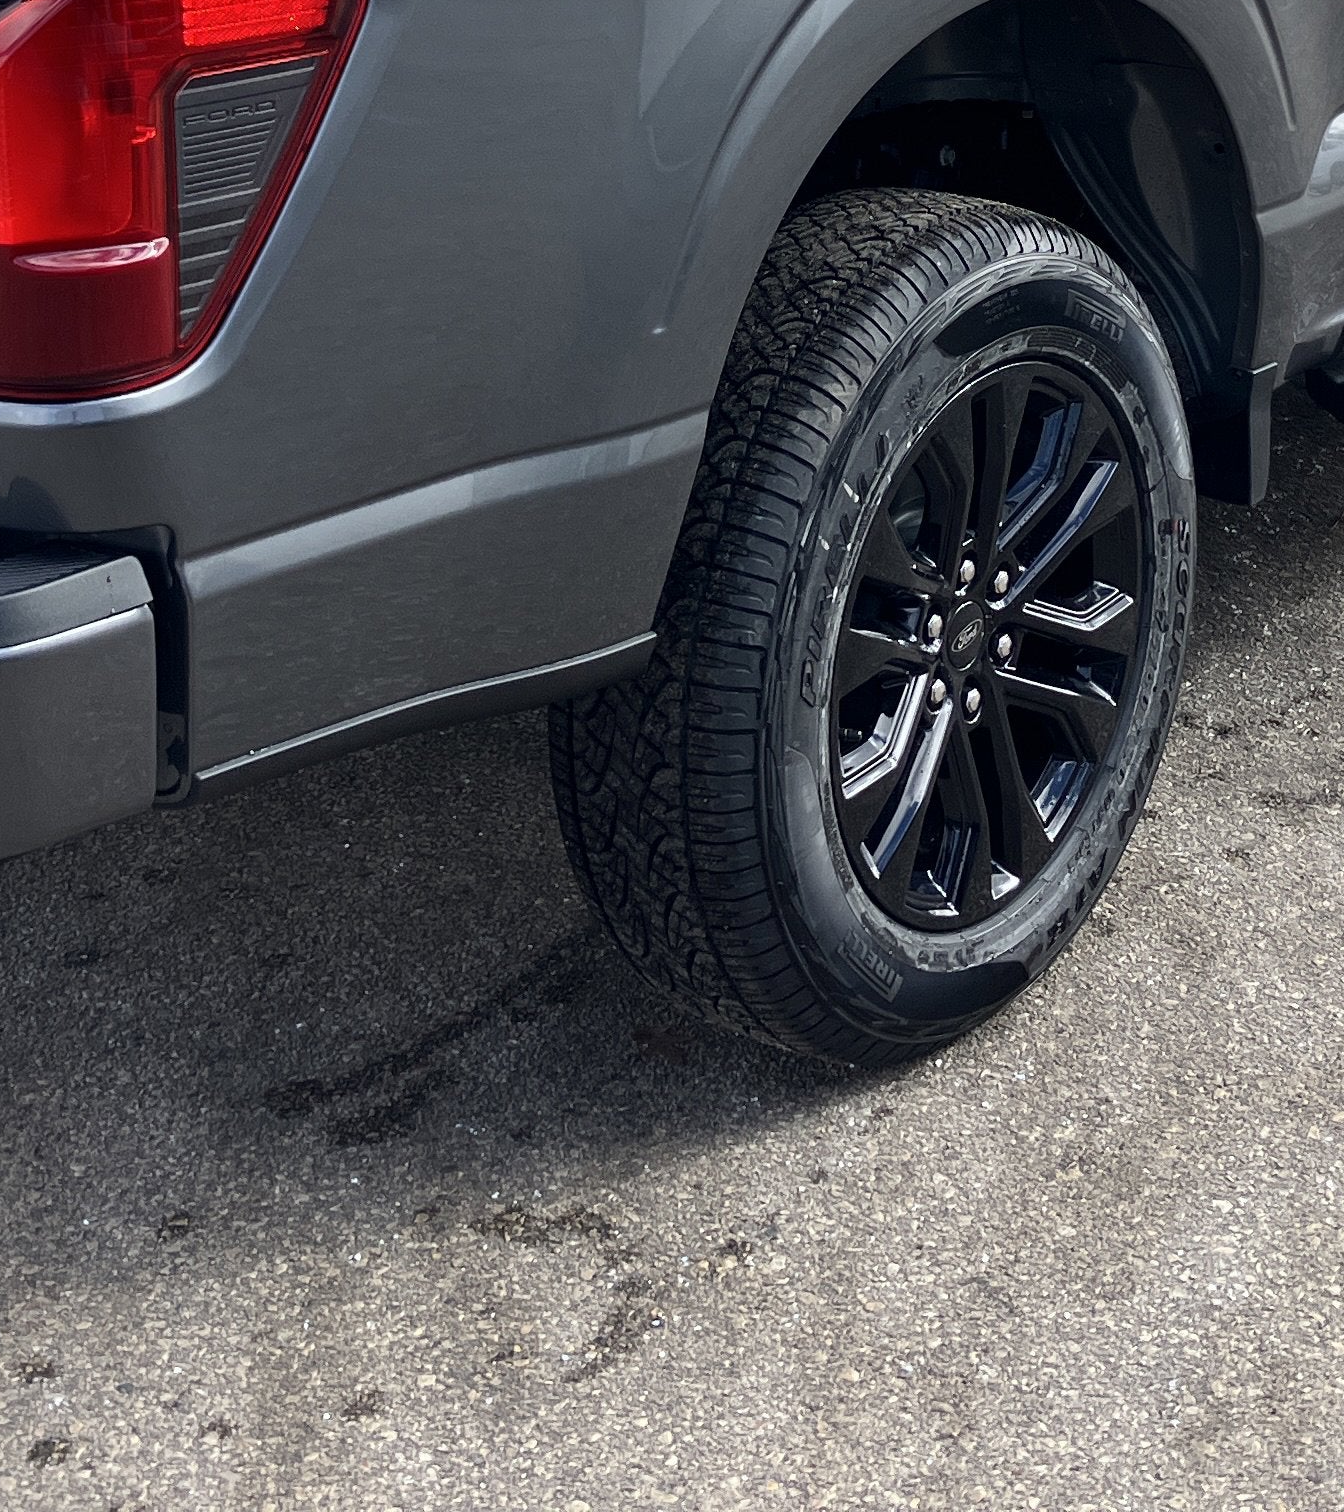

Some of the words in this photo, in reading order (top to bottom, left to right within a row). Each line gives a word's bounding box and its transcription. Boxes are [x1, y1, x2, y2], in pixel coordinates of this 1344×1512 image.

[182, 99, 277, 129] FORD
[1063, 287, 1128, 344] PIRELLI
[836, 925, 904, 1004] PIRELLI
